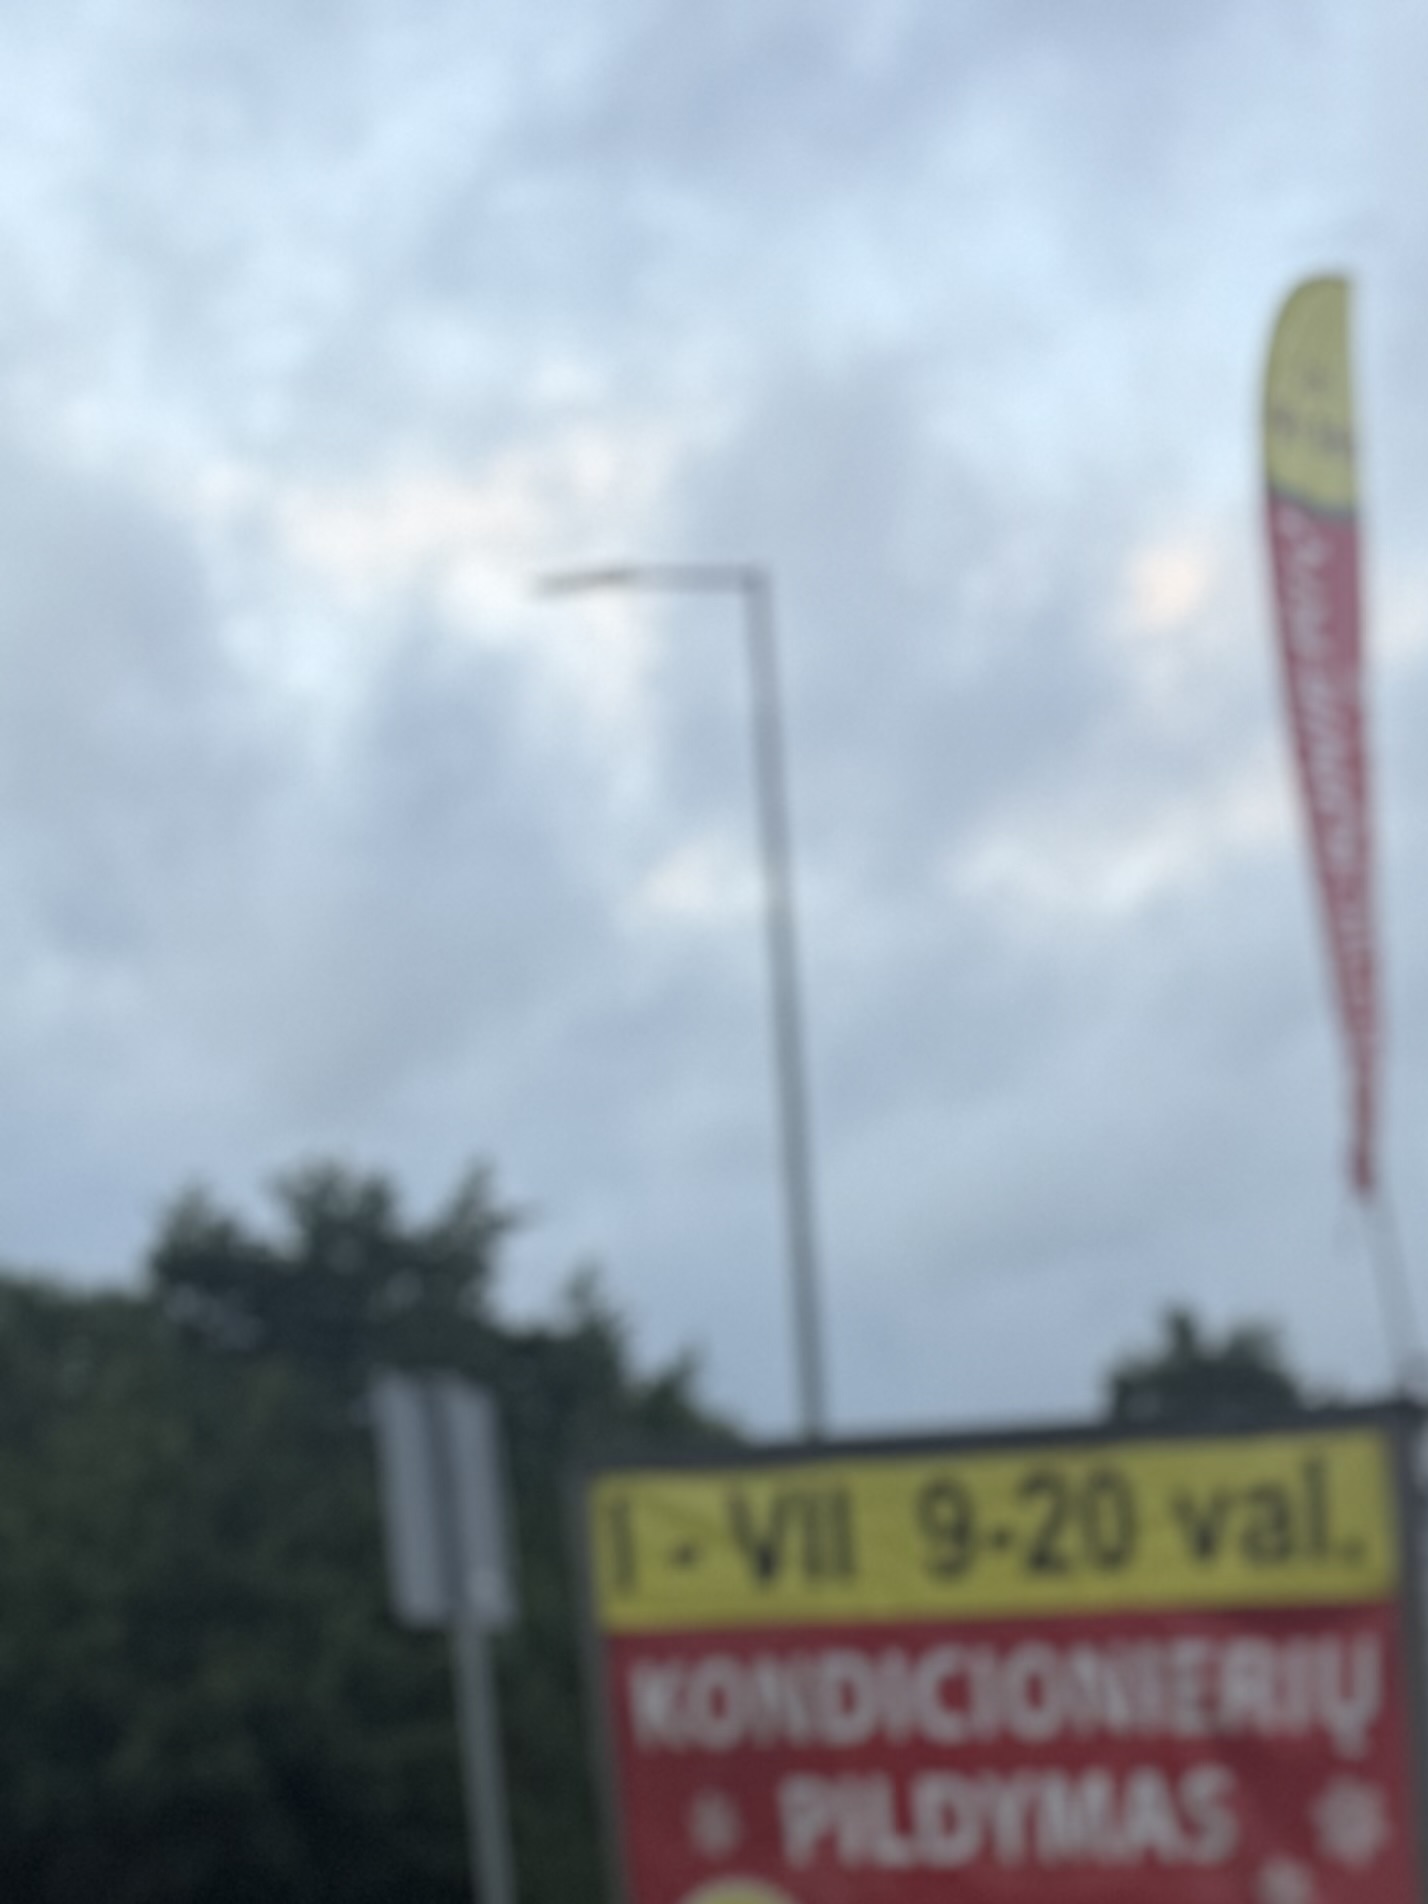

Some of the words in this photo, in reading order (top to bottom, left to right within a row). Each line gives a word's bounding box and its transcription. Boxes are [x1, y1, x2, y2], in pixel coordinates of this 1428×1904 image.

[727, 1486, 854, 1583] VII
[917, 1470, 1136, 1583] 9-20
[1172, 1456, 1367, 1564] val.
[630, 1632, 1380, 1759] KONDICIONIERIŲ
[778, 1765, 1241, 1870] PILDYMAS
